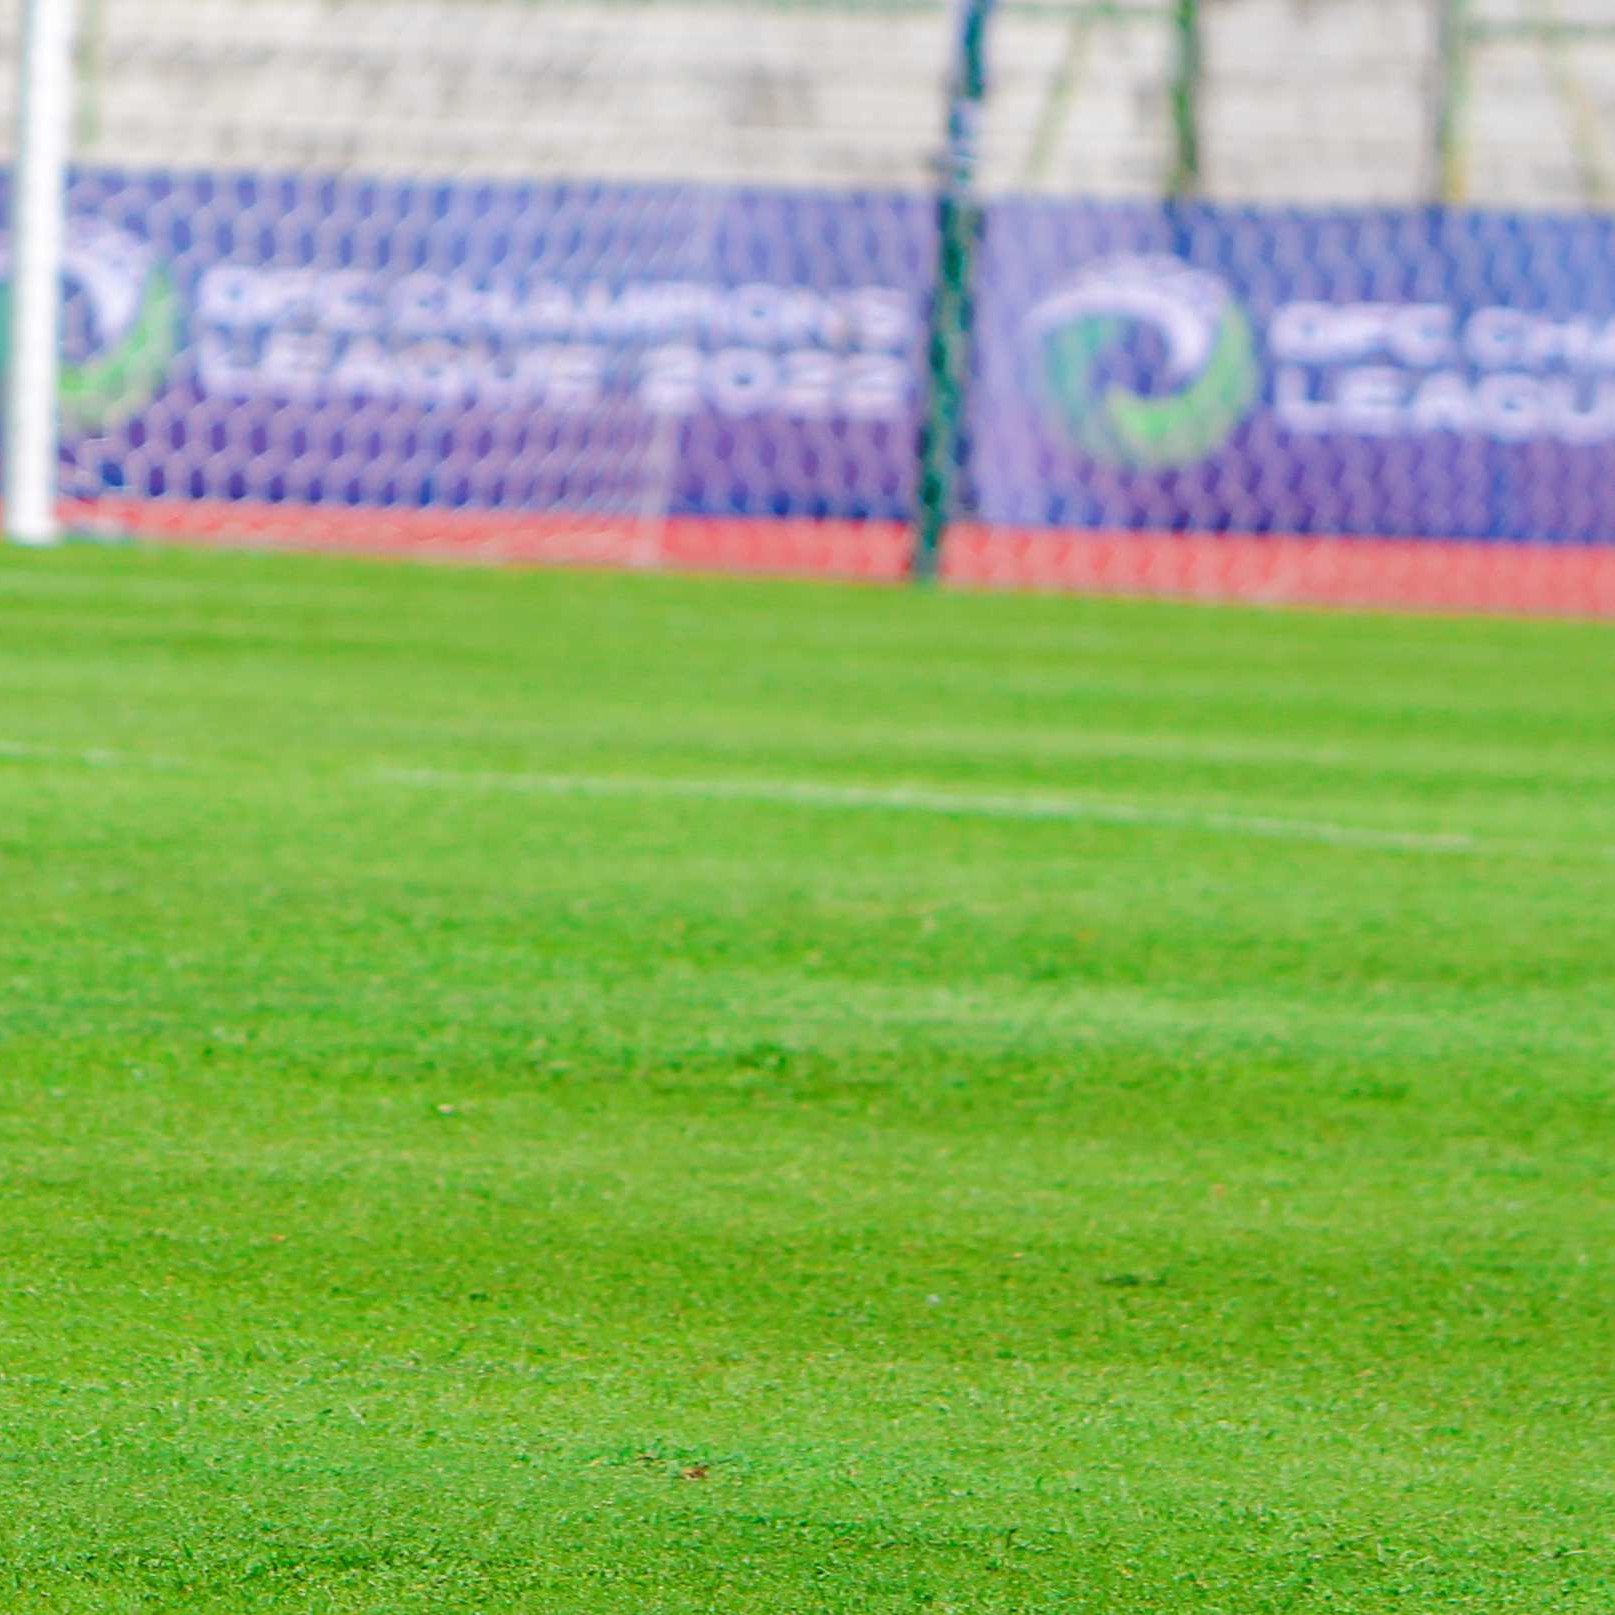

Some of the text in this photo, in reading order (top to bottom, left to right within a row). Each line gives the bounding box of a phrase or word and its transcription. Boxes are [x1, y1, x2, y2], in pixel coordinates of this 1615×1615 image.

[197, 264, 385, 330] OFC
[1270, 300, 1457, 367] OFC
[637, 344, 911, 420] 2022
